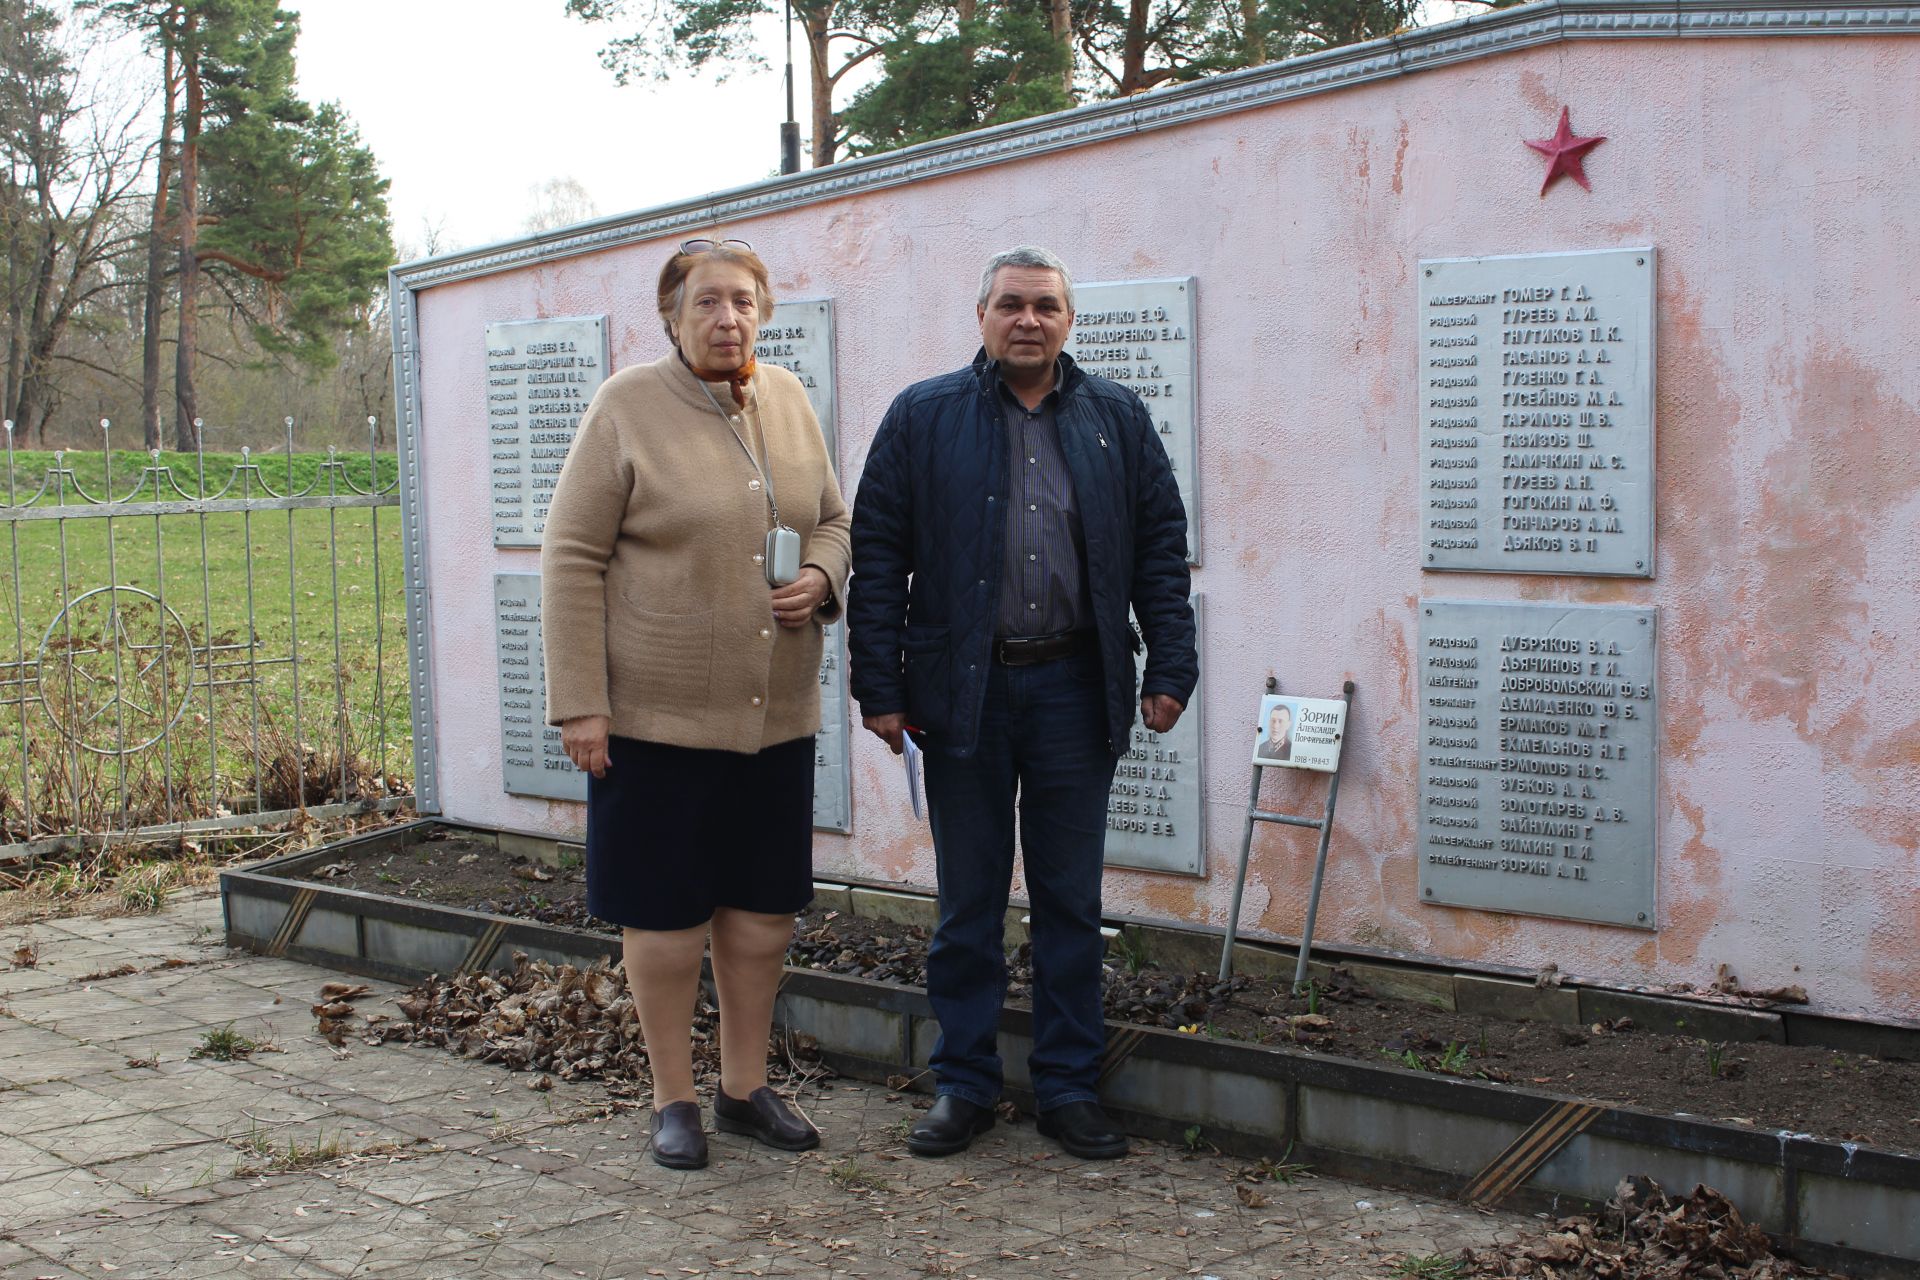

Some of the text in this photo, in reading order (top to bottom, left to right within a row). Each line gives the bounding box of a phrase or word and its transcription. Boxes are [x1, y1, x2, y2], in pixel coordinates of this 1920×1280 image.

[1503, 286, 1555, 303] ГОМЕР
[1075, 310, 1135, 326] БЕЗРУЧКО
[1430, 314, 1477, 327] РЯДОВОЙ
[1503, 307, 1557, 324] ГУРЕЕВ
[1075, 328, 1157, 344] БОНДОРЕНКО
[1430, 334, 1477, 348] РЯДОВОЙ
[1503, 327, 1582, 344] ГНУТИКОВ
[1075, 347, 1129, 362] БАХРЕЕВ
[1430, 355, 1477, 368] РЯДОВОЙ
[1503, 350, 1569, 365] ГАСАНОВ
[1430, 375, 1477, 388] РЯДОВОЙ
[1503, 370, 1567, 386] ГУЗЕНКО
[1430, 396, 1477, 408] РЯДОВОЙ
[1503, 388, 1579, 406] ГУСЕЙНОВ
[1430, 416, 1477, 429] РЯДОВОЙ
[1503, 412, 1571, 427] ГАРИЛОВ
[1430, 436, 1477, 449] РЯДОВОЙ
[1503, 433, 1569, 448] ГАЗИЗОВ
[1430, 456, 1477, 469] РЯДОВОЙ
[1503, 454, 1583, 469] ГАЛИЧКИН
[1430, 477, 1477, 490] РЯДОВОЙ
[1503, 474, 1557, 490] ГУРЕЕВ
[1430, 498, 1477, 510] РЯДОВОЙ
[1503, 495, 1571, 511] ГОГОКИН
[1430, 518, 1477, 530] РЯДОВОЙ
[1503, 515, 1581, 532] ГОНЧАРОВ
[1430, 538, 1477, 550] РЯДОВОЙ
[1503, 535, 1561, 552] ДЬЯКОВ
[1428, 636, 1478, 649] РЯДОВОЙ
[1500, 635, 1580, 653] ДУБРЯКОВ
[1428, 656, 1478, 669] РЯДОВОЙ
[1500, 656, 1581, 674] ДЬЯЧИНОВ
[1428, 676, 1479, 689] ЛЕЙТЕНАТ
[1500, 677, 1615, 697] ДОБРОВОЛЬСКИЙ
[1428, 696, 1476, 709] СЕРЖАНТ
[1500, 697, 1594, 716] ДЕМИДЕНКО
[1428, 716, 1478, 729] РЯДОВОЙ
[1500, 718, 1569, 736] ЕРМАКОВ
[1428, 736, 1478, 749] РЯДОВОЙ
[1500, 737, 1592, 757] ЕХМЕЛЬНОВ
[1500, 757, 1568, 777] ЕРМОЛОВ
[1500, 777, 1555, 795] ЗУБКОВ
[1500, 798, 1586, 818] ЗОЛОТАРЕВ
[1500, 815, 1576, 838] ЗАЙНУЛИН
[1500, 839, 1554, 856] ЗИМИН
[1500, 857, 1549, 876] ЗОРИН
